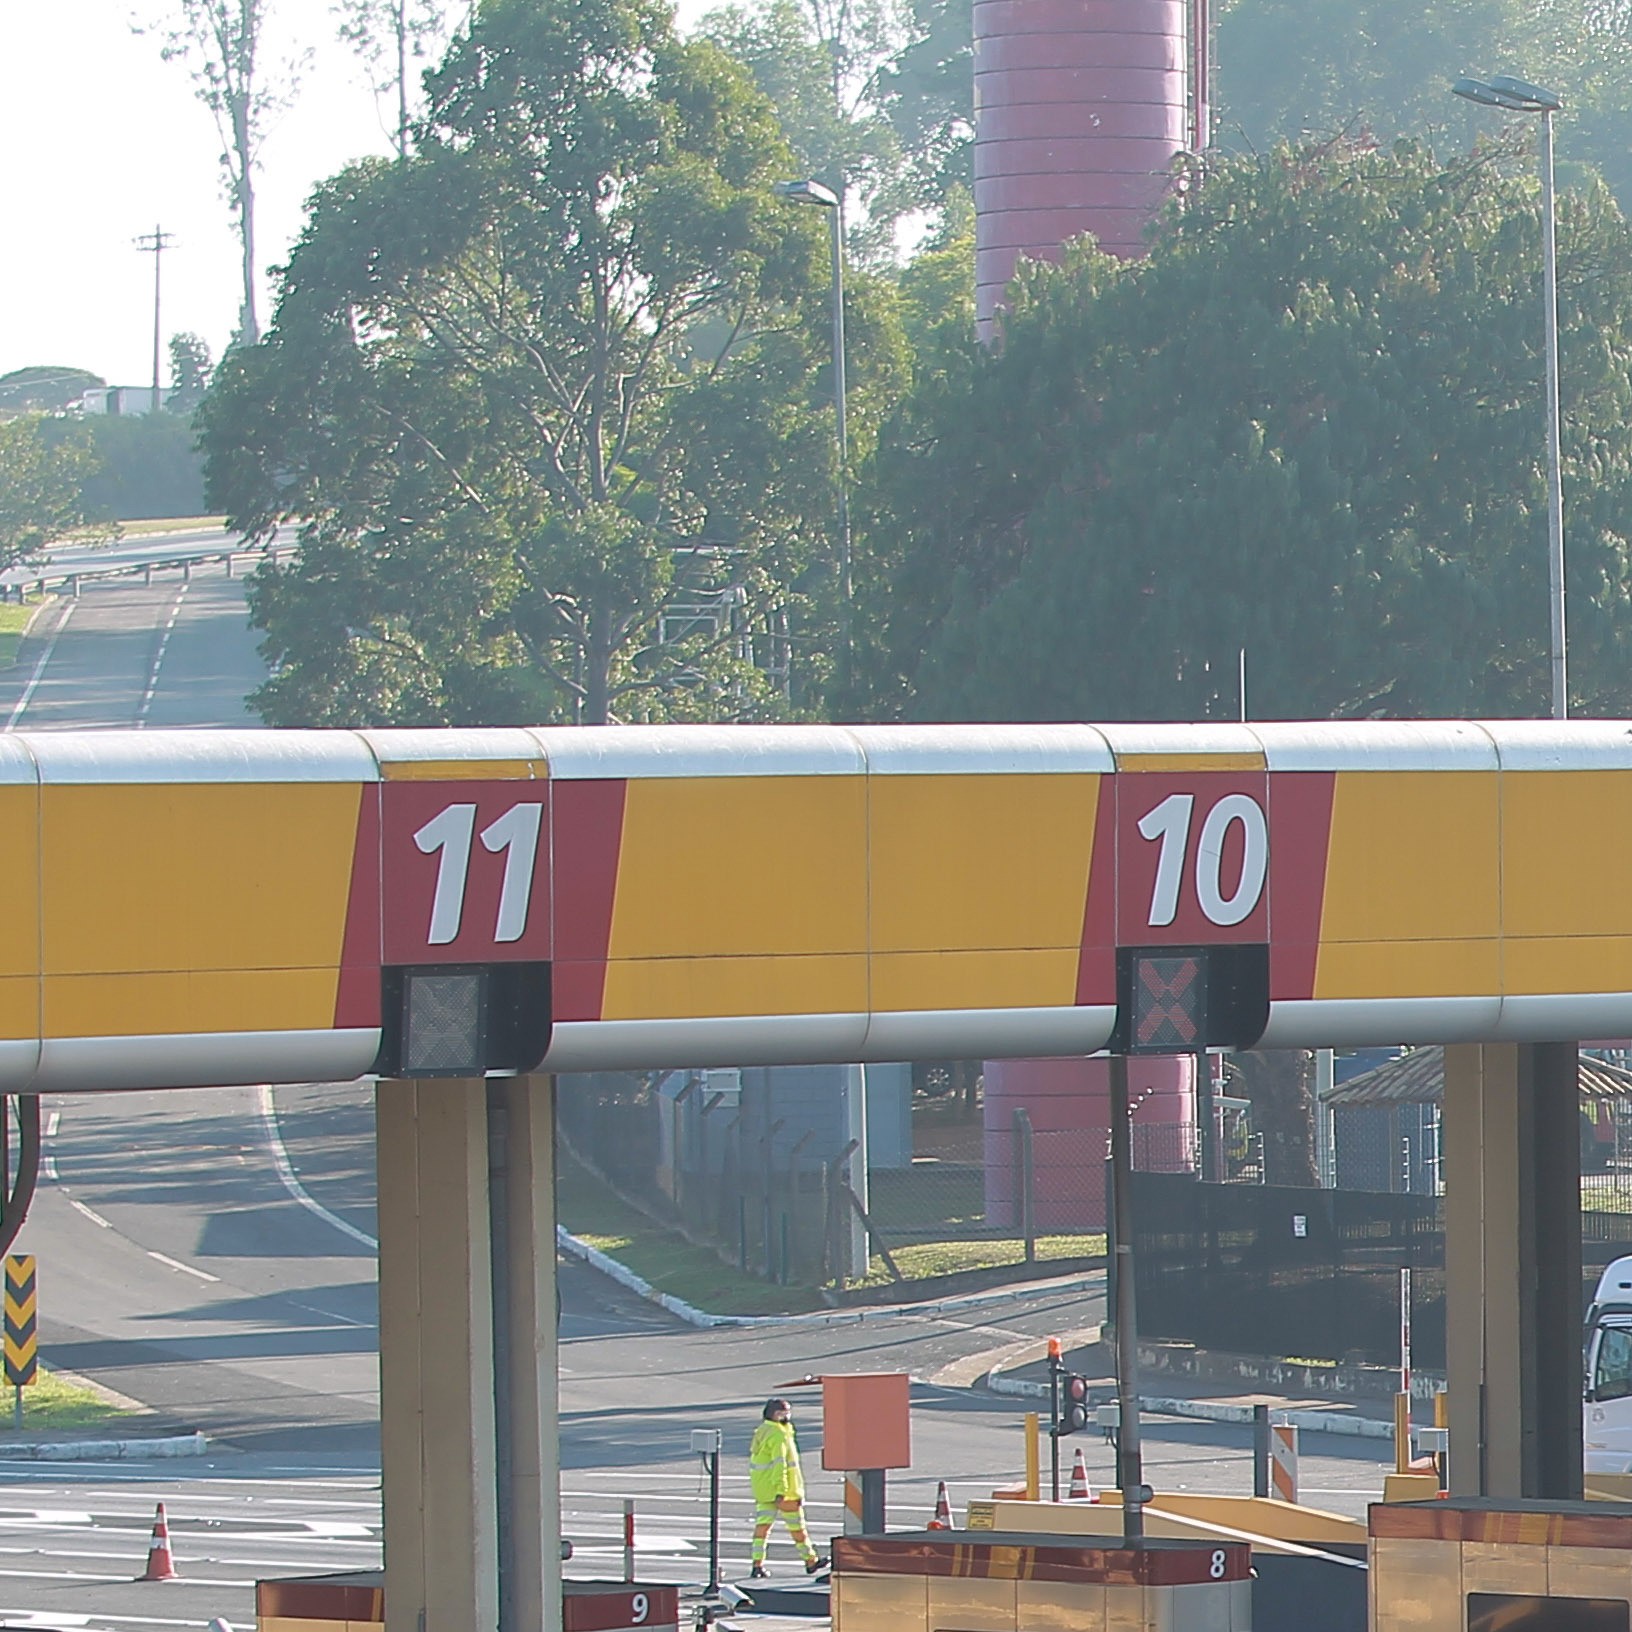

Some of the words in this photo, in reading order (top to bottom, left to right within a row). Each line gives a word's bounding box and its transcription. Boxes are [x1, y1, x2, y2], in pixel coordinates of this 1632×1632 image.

[411, 801, 545, 946] 11
[1135, 792, 1269, 927] 10
[1209, 1549, 1227, 1579] 8
[632, 1593, 649, 1623] 9
